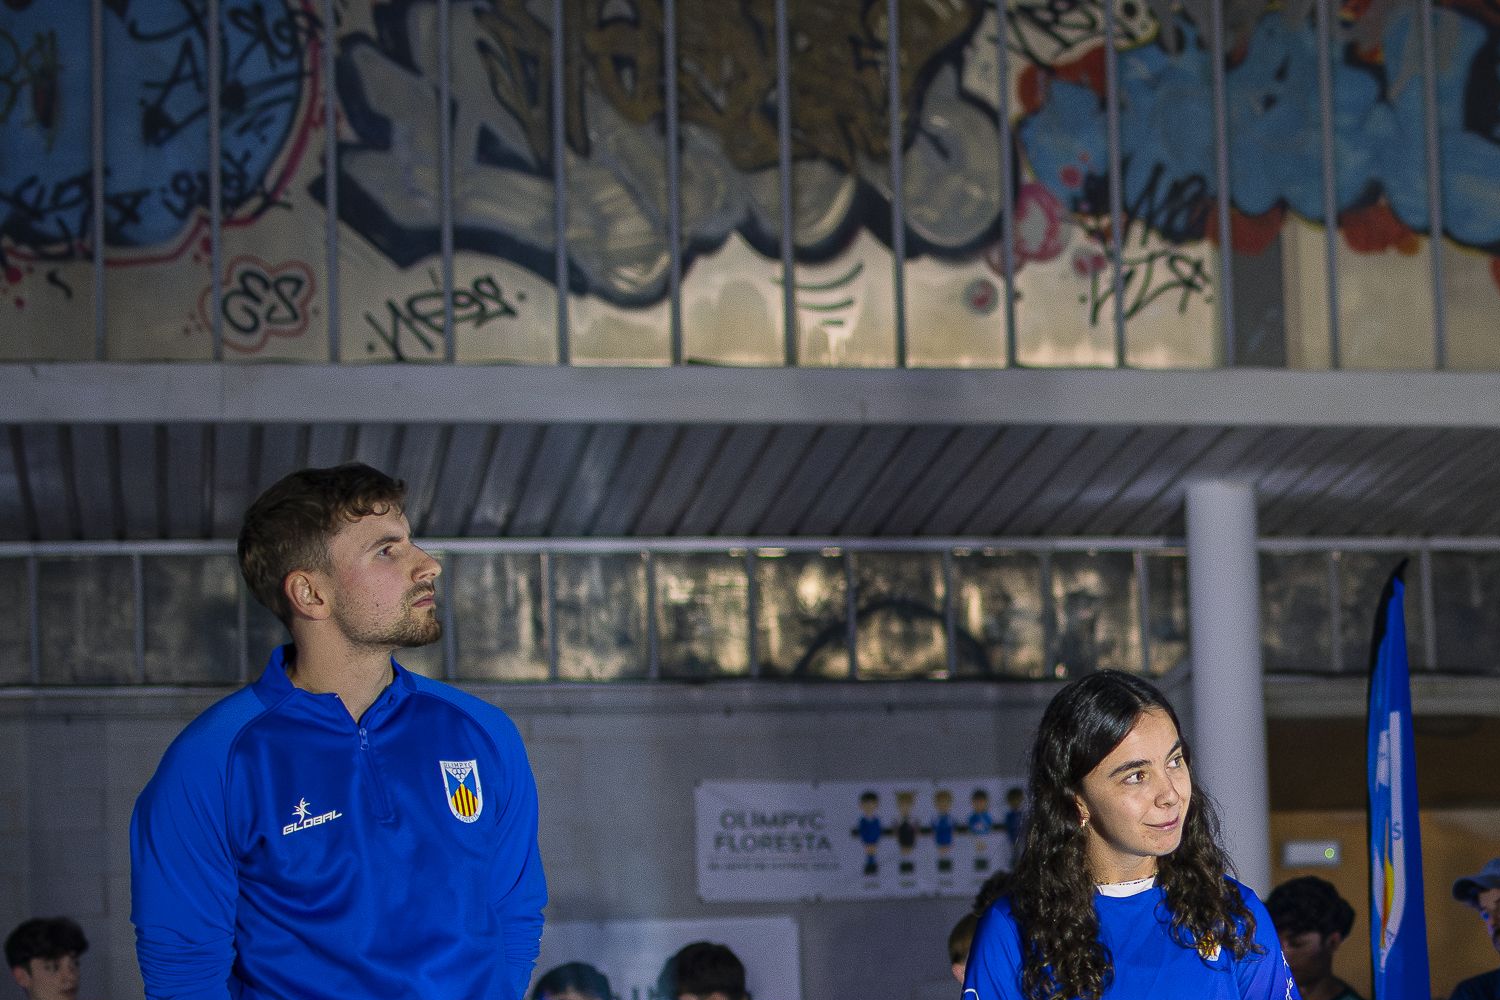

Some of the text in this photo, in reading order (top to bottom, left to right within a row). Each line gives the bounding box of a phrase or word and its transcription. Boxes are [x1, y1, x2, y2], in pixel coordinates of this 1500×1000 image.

[282, 810, 343, 836] GLOBAL
[718, 808, 826, 831] OLIMPYC
[712, 831, 833, 852] FLORESTA
